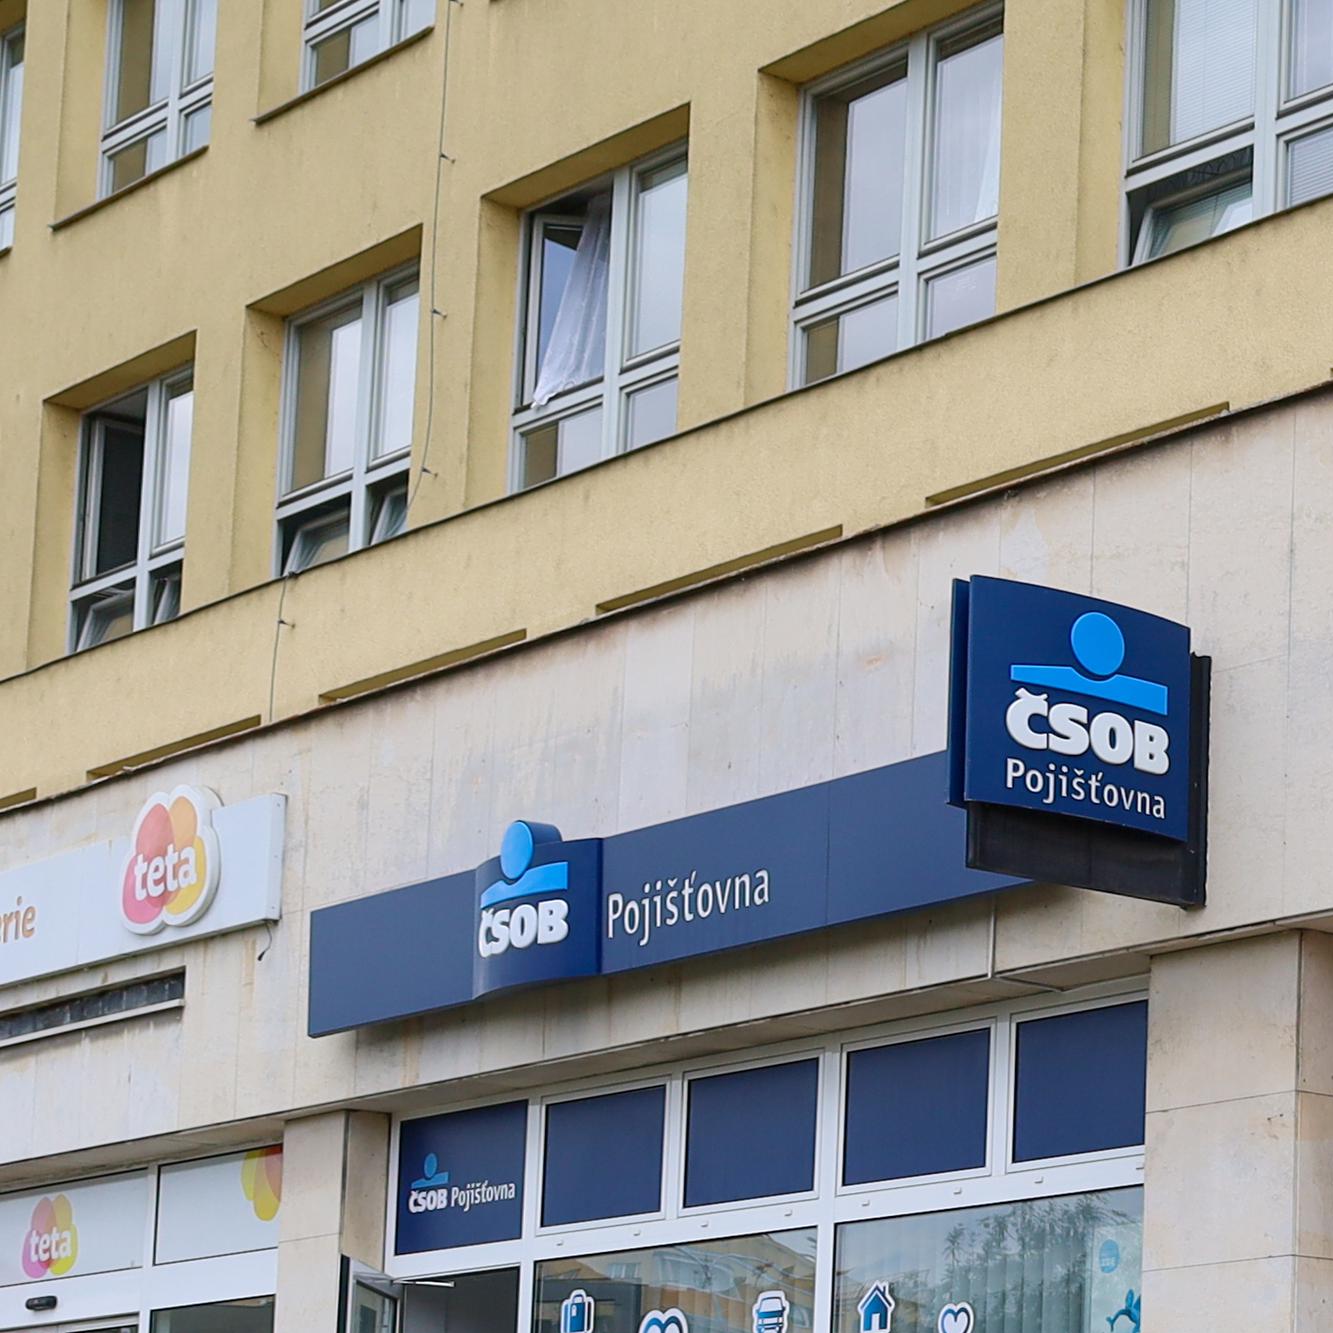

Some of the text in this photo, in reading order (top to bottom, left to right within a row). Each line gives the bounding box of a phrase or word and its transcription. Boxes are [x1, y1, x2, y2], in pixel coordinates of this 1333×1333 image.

[1005, 687, 1171, 776] ČSOB
[1005, 757, 1167, 820] Pojišťovna
[134, 843, 197, 899] teta
[0, 895, 37, 943] rie
[478, 866, 770, 958] ČSOB Pojišťovna
[408, 1180, 516, 1213] ČSOB Pojišťovna
[29, 1222, 72, 1264] teta
